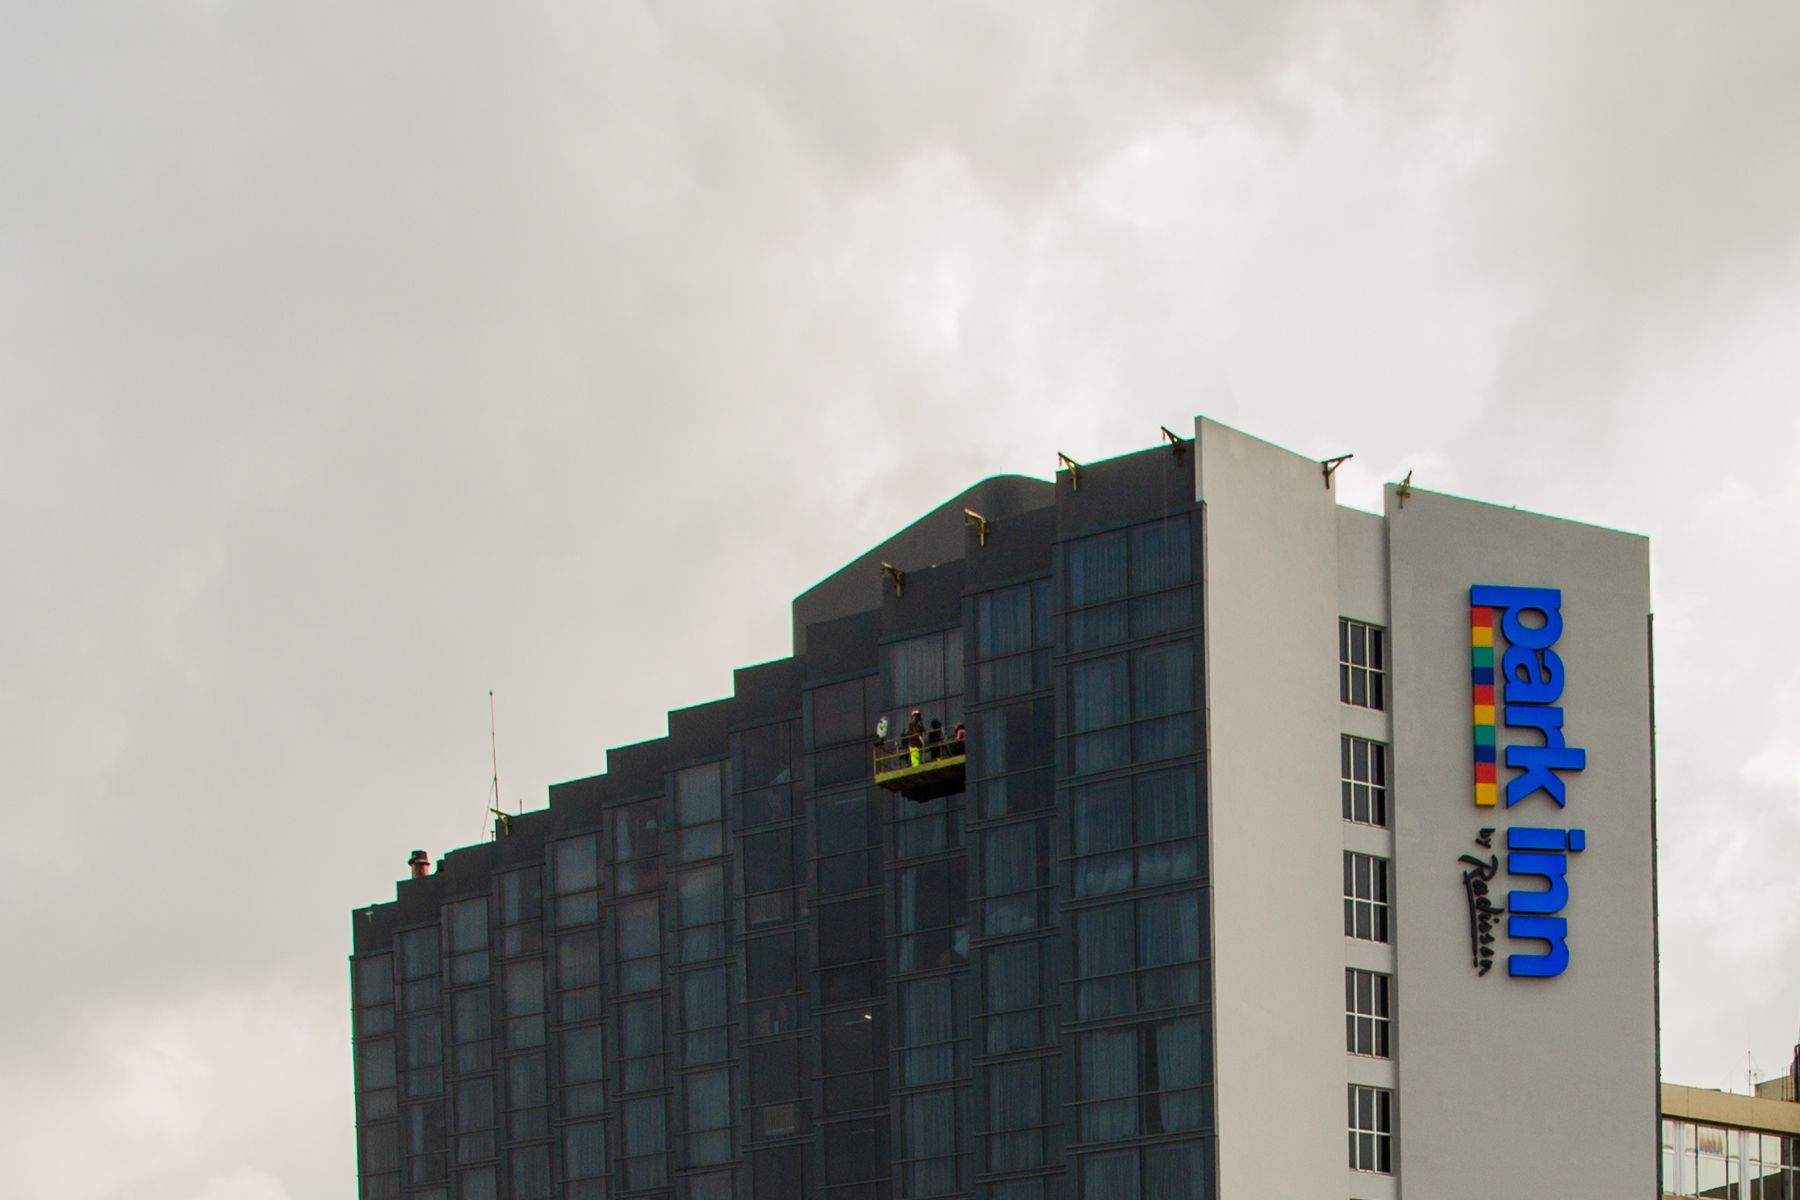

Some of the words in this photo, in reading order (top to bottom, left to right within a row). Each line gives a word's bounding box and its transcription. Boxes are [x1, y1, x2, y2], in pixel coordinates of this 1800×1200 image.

[1470, 584, 1586, 809] park
[1475, 827, 1496, 849] by
[1507, 826, 1586, 978] inn
[1458, 853, 1505, 977] Radisson
